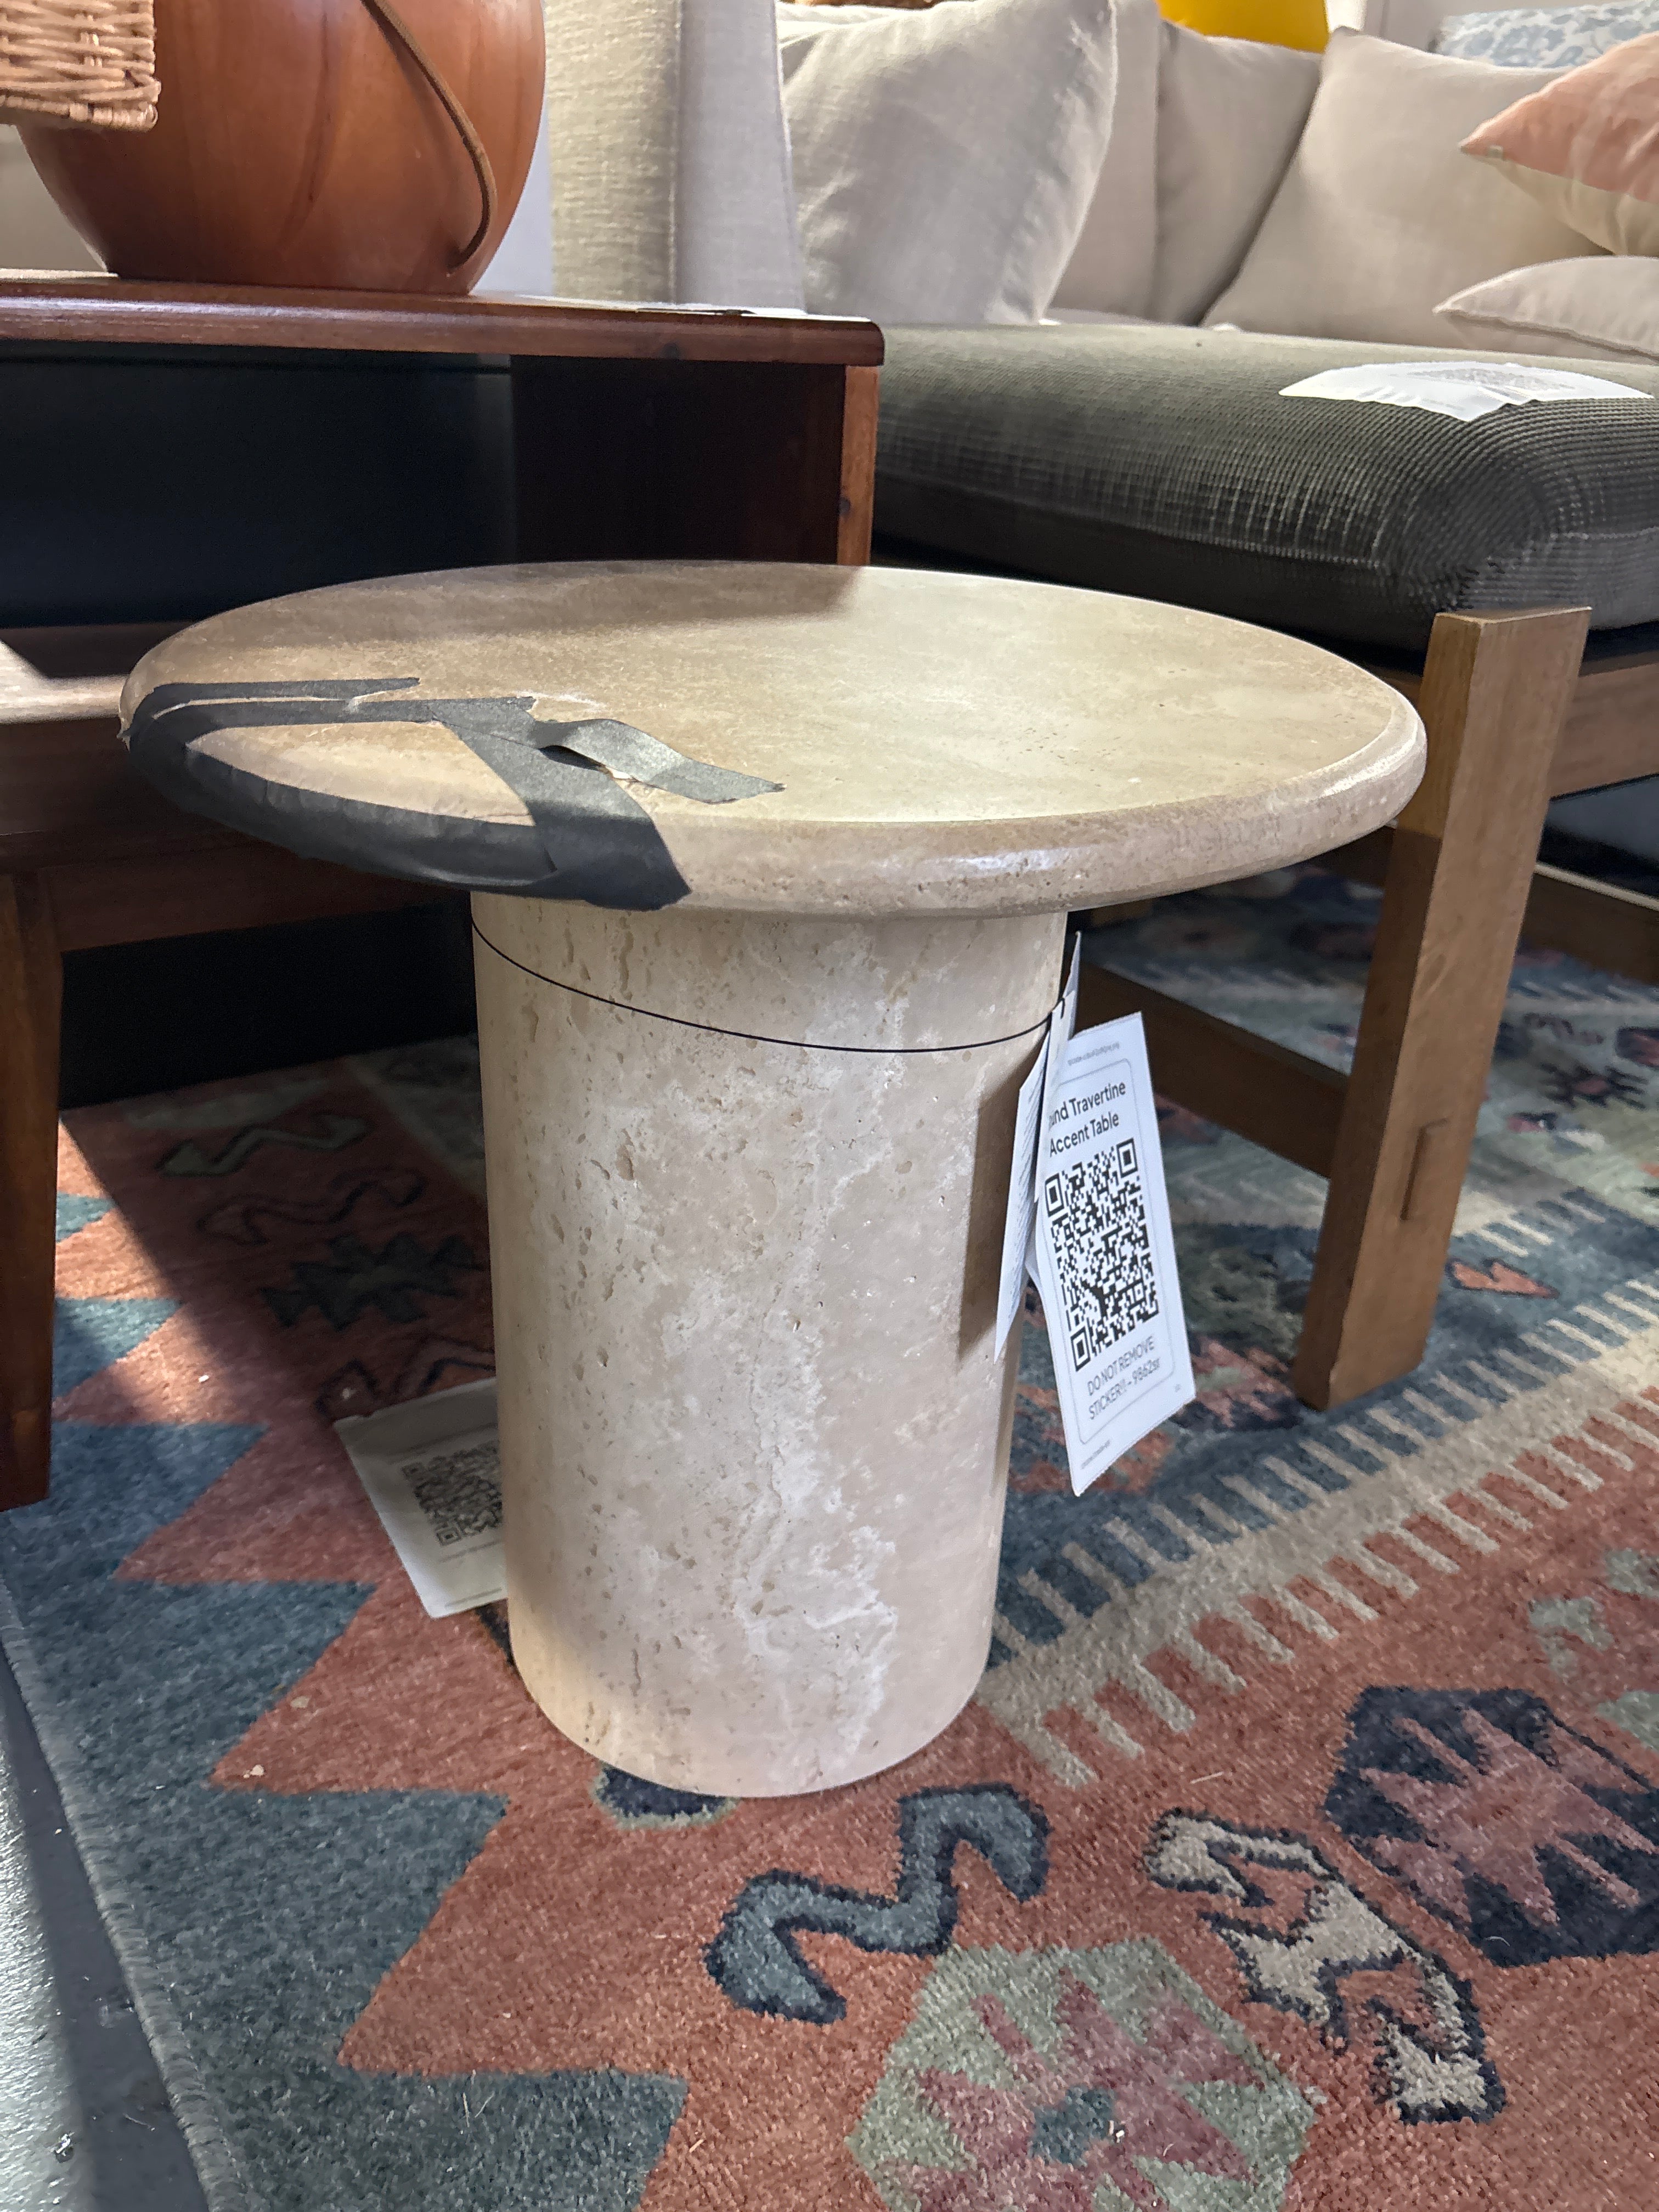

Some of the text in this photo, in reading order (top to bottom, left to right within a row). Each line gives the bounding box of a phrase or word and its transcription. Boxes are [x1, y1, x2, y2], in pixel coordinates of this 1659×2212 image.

[1069, 1082, 1126, 1116] Travertine
[1049, 1111, 1119, 1158] Accent Table
[1087, 1335, 1155, 1396] DO NOT REMOVE
